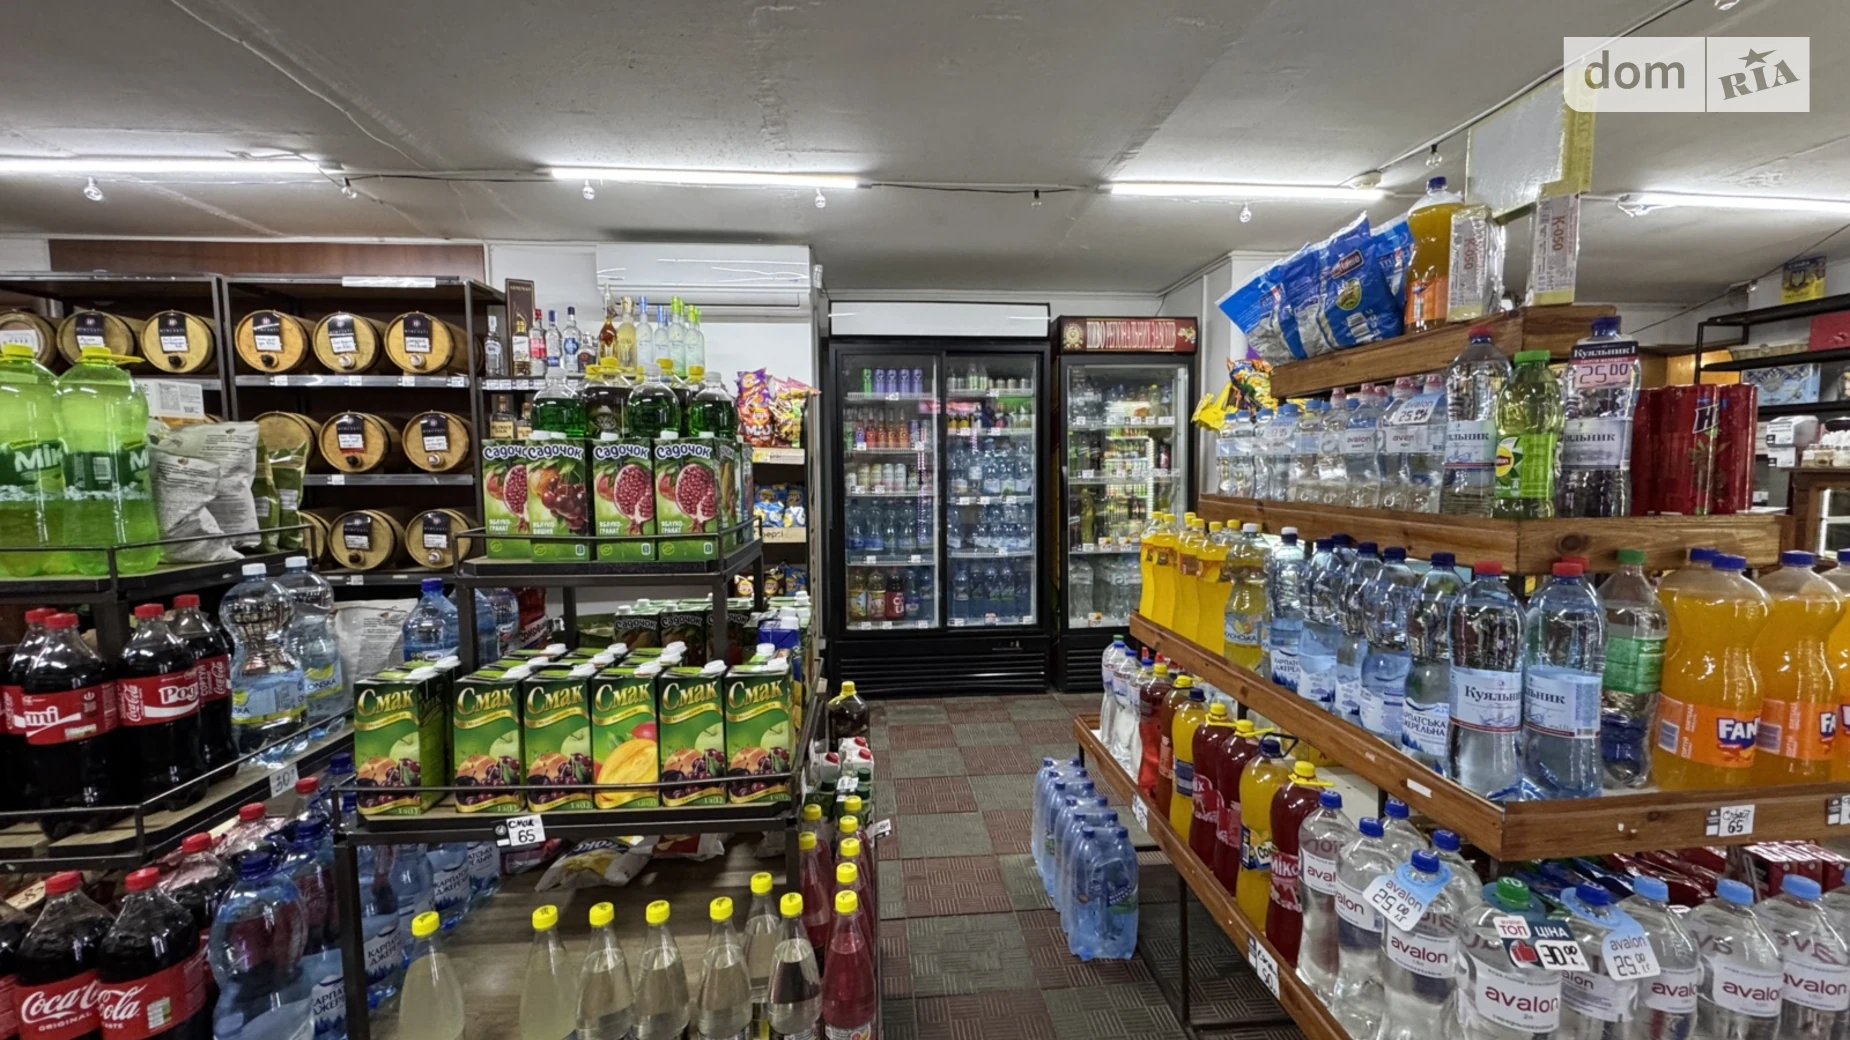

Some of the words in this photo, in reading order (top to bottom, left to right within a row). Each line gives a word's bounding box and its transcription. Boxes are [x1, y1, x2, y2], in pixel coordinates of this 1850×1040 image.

[1551, 216, 1566, 251] K-050
[1464, 237, 1476, 270] K-050
[745, 425, 773, 436] MAX
[527, 444, 583, 460] Садочок
[594, 444, 649, 460] Садочок
[655, 443, 711, 460] Садочок
[615, 618, 657, 631] Садочок
[124, 682, 141, 722] Coca-Cola
[357, 687, 415, 717] Смак
[457, 686, 514, 716] Смак
[527, 685, 584, 715] Смак
[595, 682, 651, 713] Смак
[662, 679, 718, 711] Смак
[728, 679, 783, 709] Смак
[517, 829, 536, 844] 65
[1728, 820, 1744, 834] 65
[1385, 879, 1422, 912] avalon
[1499, 925, 1528, 936] ТОП
[1534, 925, 1570, 939] ЦІНА
[1610, 935, 1647, 951] avalon
[1391, 935, 1448, 964] avalon
[1485, 985, 1559, 1013] avalon
[38, 1011, 93, 1032] ORIGINAL
